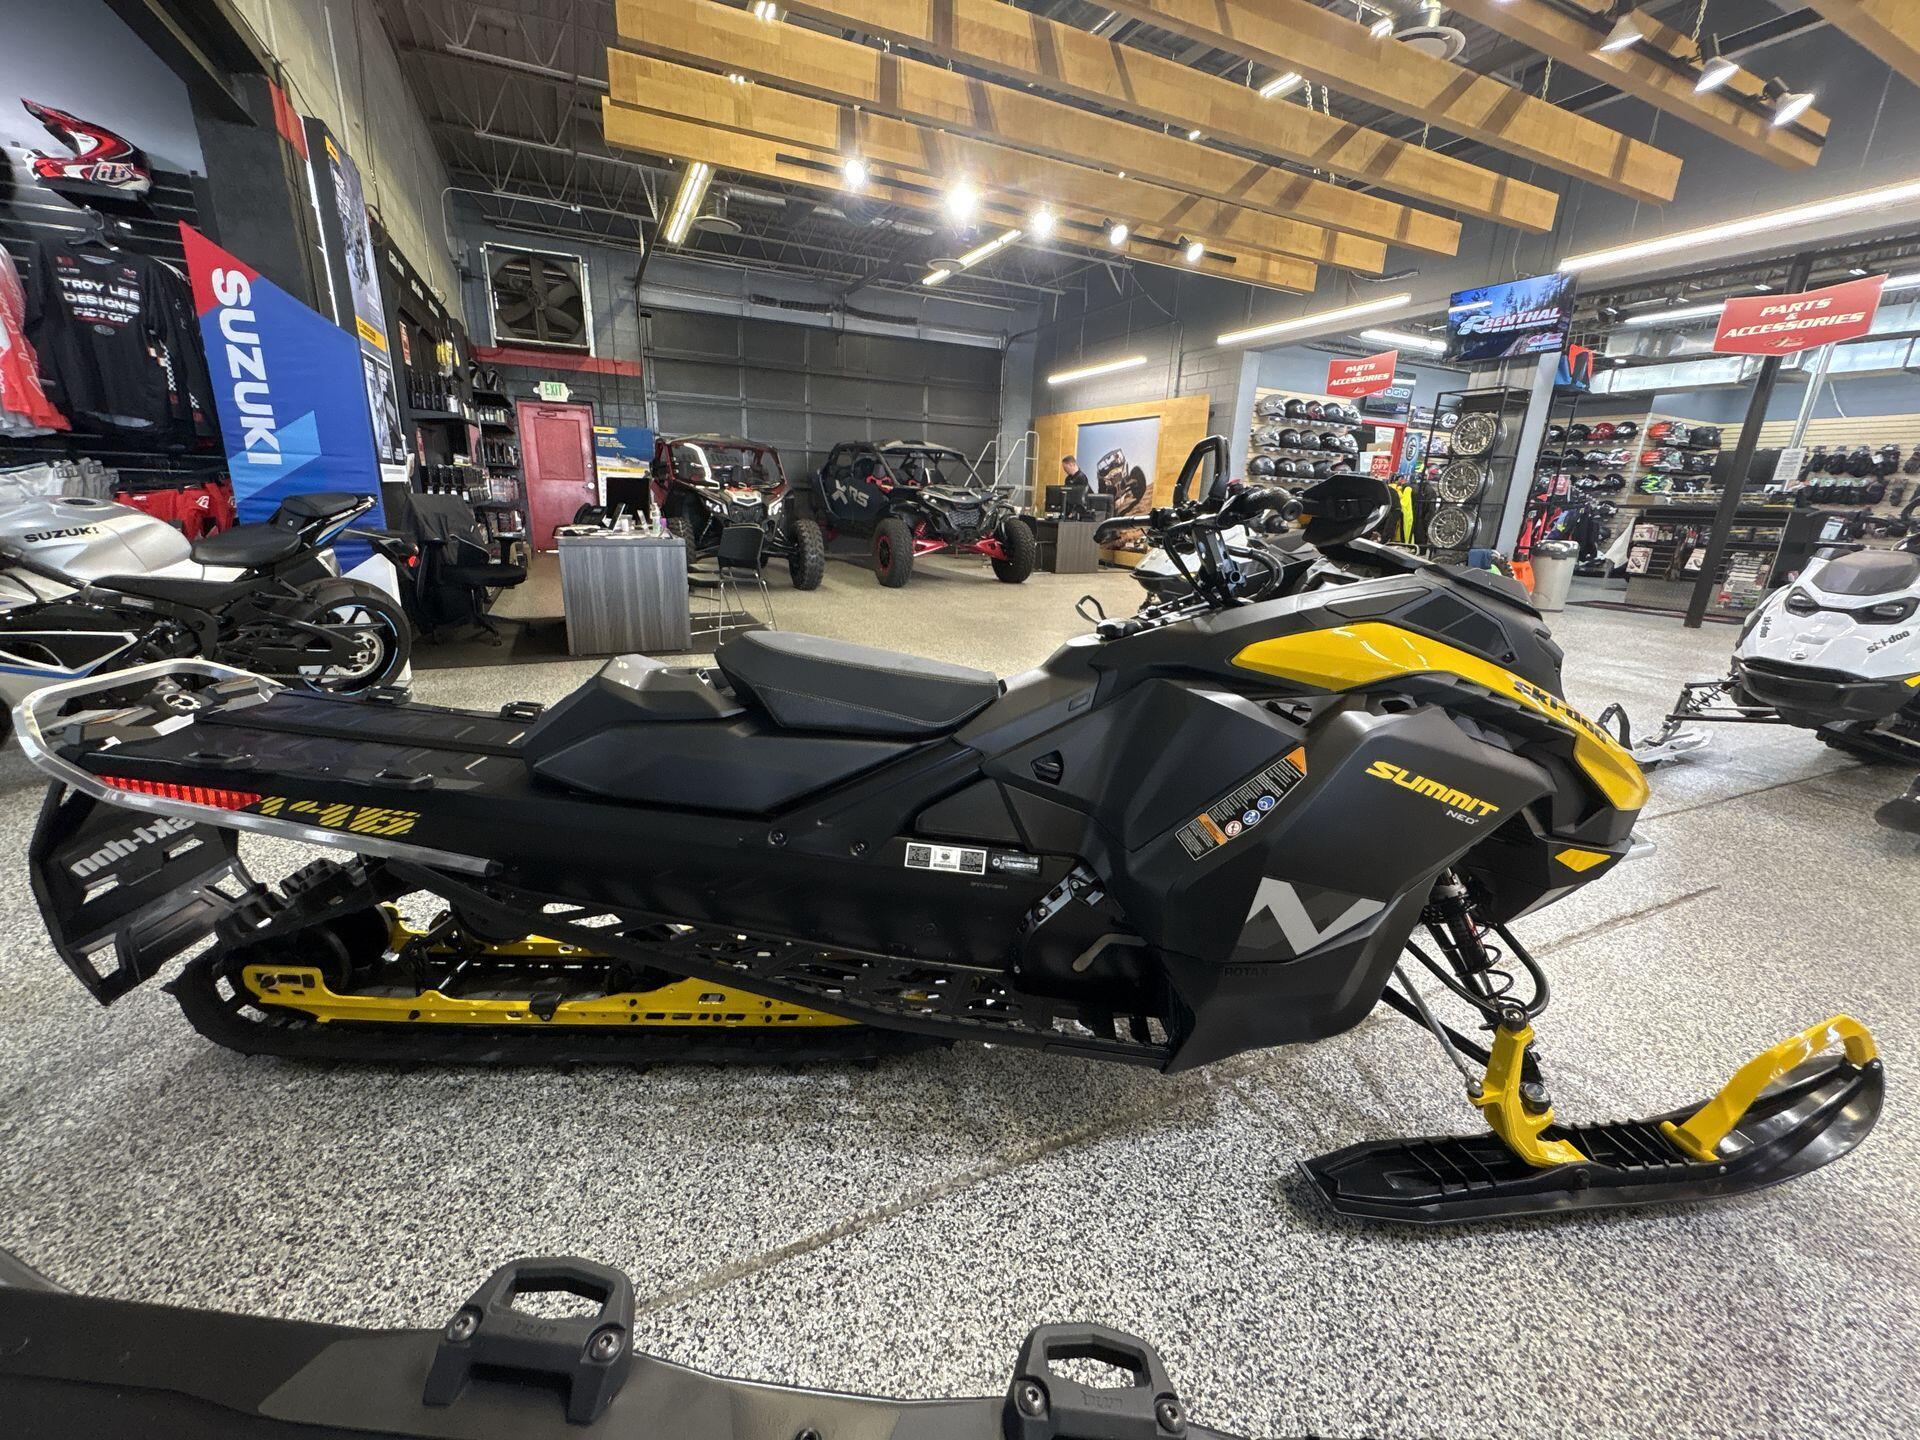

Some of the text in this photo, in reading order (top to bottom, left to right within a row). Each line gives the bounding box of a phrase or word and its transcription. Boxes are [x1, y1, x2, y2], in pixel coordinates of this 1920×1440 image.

[58, 277, 140, 300] TROY LEE
[63, 292, 140, 314] DESIGNS
[1760, 298, 1833, 317] PARTS
[1483, 307, 1560, 328] RENTHAL
[1722, 311, 1866, 339] ACCESSORIES
[1784, 313, 1799, 321] &
[211, 267, 282, 465] SUZUKI
[1344, 362, 1376, 374] PARTS
[544, 382, 562, 397] EXIT
[1329, 373, 1391, 387] ACCESSORIES
[24, 526, 99, 543] SUZUKI
[1866, 630, 1911, 654] ski-doo
[1513, 680, 1607, 744] ski-doo
[1365, 760, 1500, 816] SUMMIT
